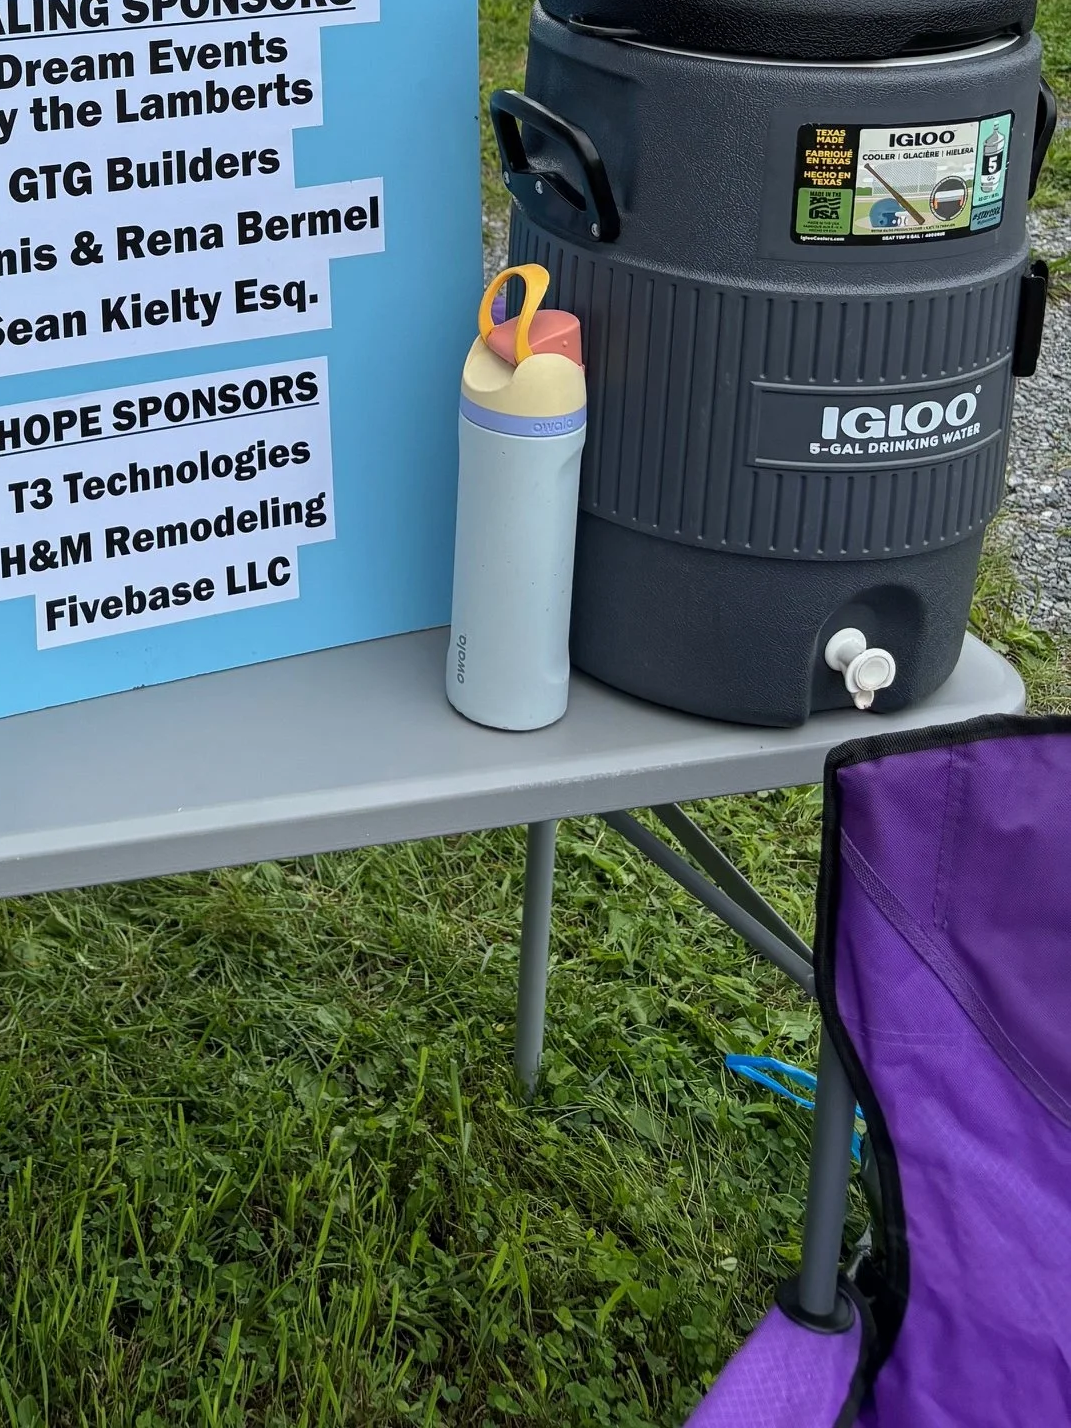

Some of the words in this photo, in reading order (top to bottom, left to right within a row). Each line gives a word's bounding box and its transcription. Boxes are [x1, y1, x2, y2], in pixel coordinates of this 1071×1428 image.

[149, 31, 288, 75] Events
[29, 95, 103, 132] the
[115, 73, 314, 124] Lamberts
[805, 149, 853, 157] FABRIQUÉ
[889, 131, 955, 147] IGLOO
[903, 150, 939, 159] GLACIÈRE
[946, 148, 973, 156] HIELERA
[8, 161, 93, 203] GTG
[106, 146, 281, 193] Builders
[988, 156, 997, 173] 5
[70, 230, 104, 267] &
[116, 223, 224, 261] Rena
[237, 195, 380, 246] Bermel
[101, 287, 222, 333] Kielty
[234, 278, 319, 314] Esq.
[112, 371, 319, 432] SPONSORS
[533, 417, 573, 433] owala
[822, 393, 977, 439] IGLOO
[809, 443, 863, 454] 5-GAL
[868, 436, 938, 454] DRINKING
[942, 423, 980, 444] WATER
[8, 477, 54, 514] T3
[62, 439, 311, 505] Technologies
[0, 531, 93, 579] H&M
[104, 491, 327, 559] Remodeling
[45, 577, 215, 632] Fivebase
[226, 556, 291, 596] LLC
[457, 634, 467, 684] owala
